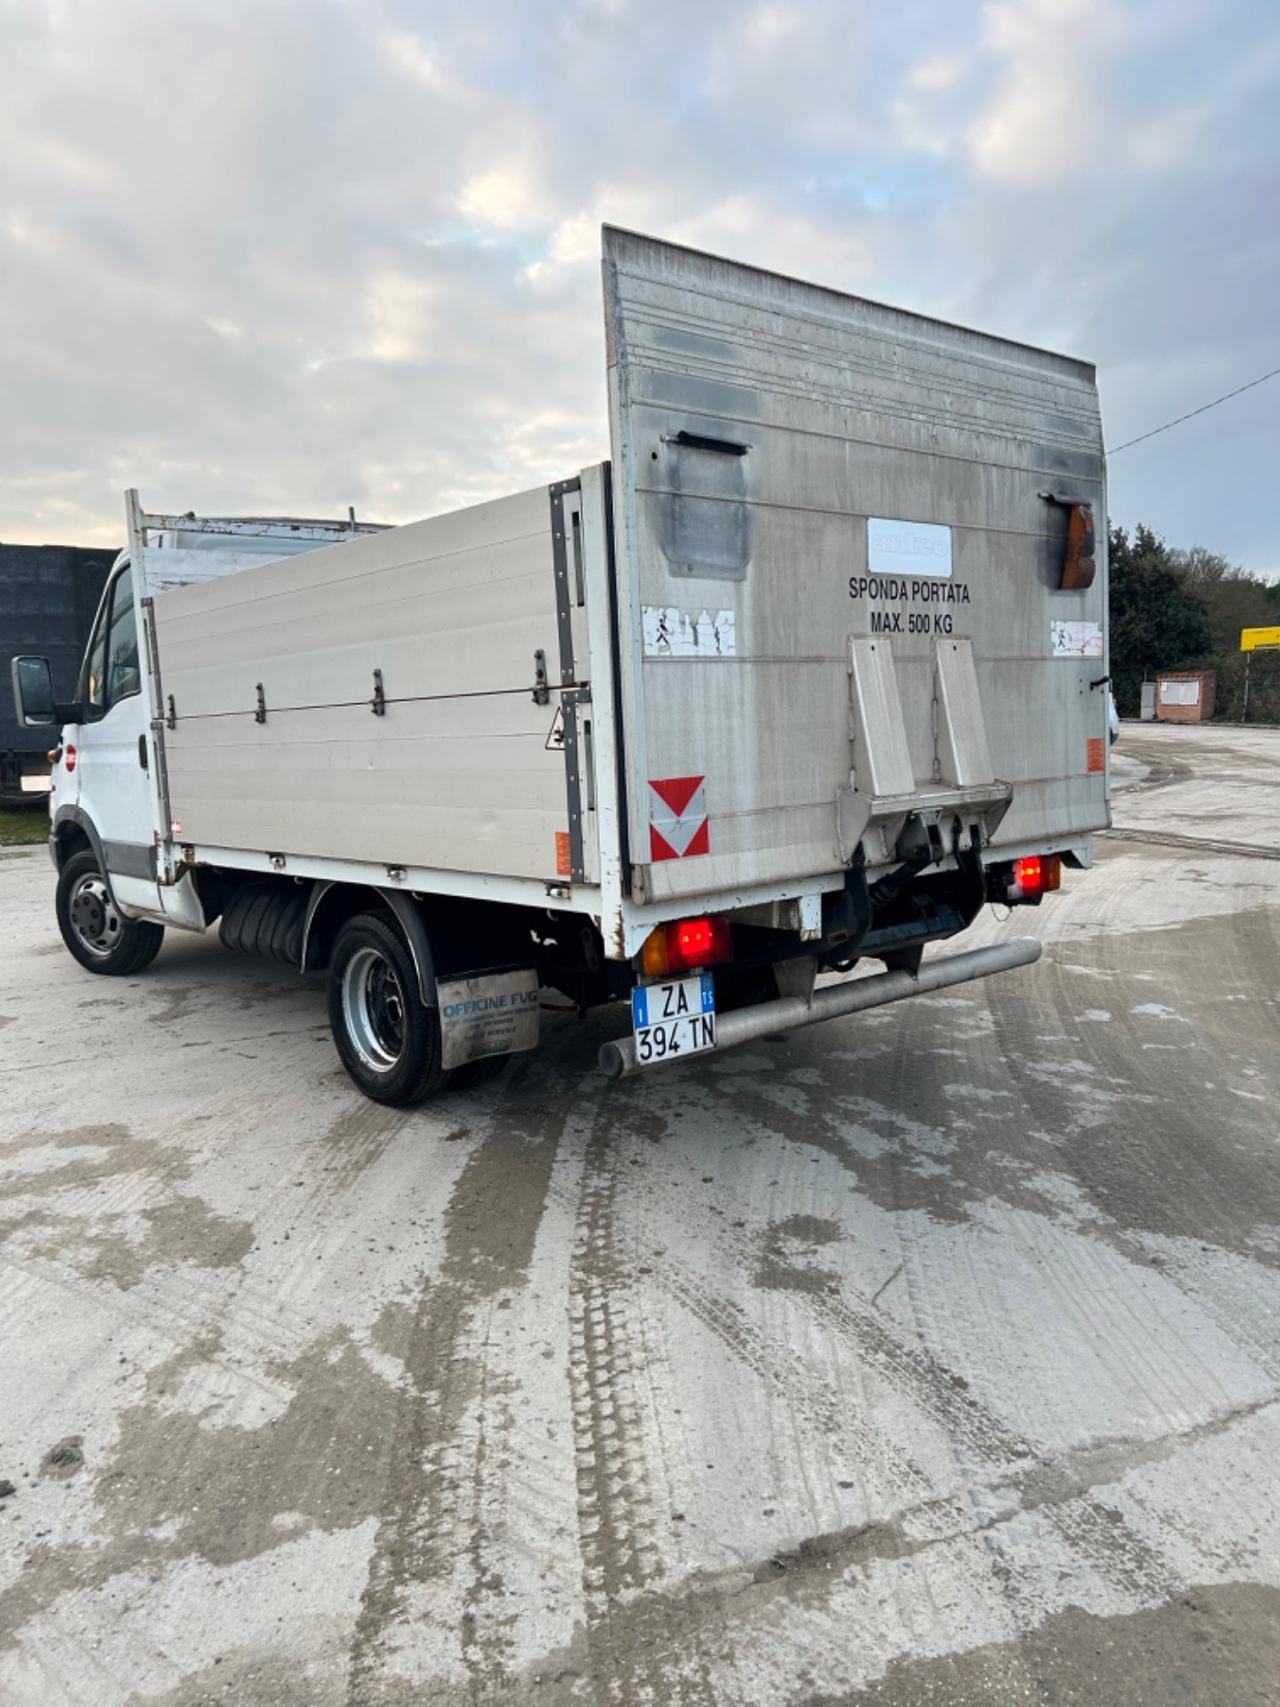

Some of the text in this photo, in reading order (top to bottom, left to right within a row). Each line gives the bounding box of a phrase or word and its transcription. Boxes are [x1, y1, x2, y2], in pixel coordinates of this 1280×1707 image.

[849, 577, 971, 603] SPONDA PORTATA
[871, 611, 953, 634] MAX. 500 KG
[443, 994, 507, 1018] OFFICINE
[511, 990, 538, 1005] FVG
[661, 983, 688, 1018] ZA
[638, 1013, 715, 1060] 394 TN
